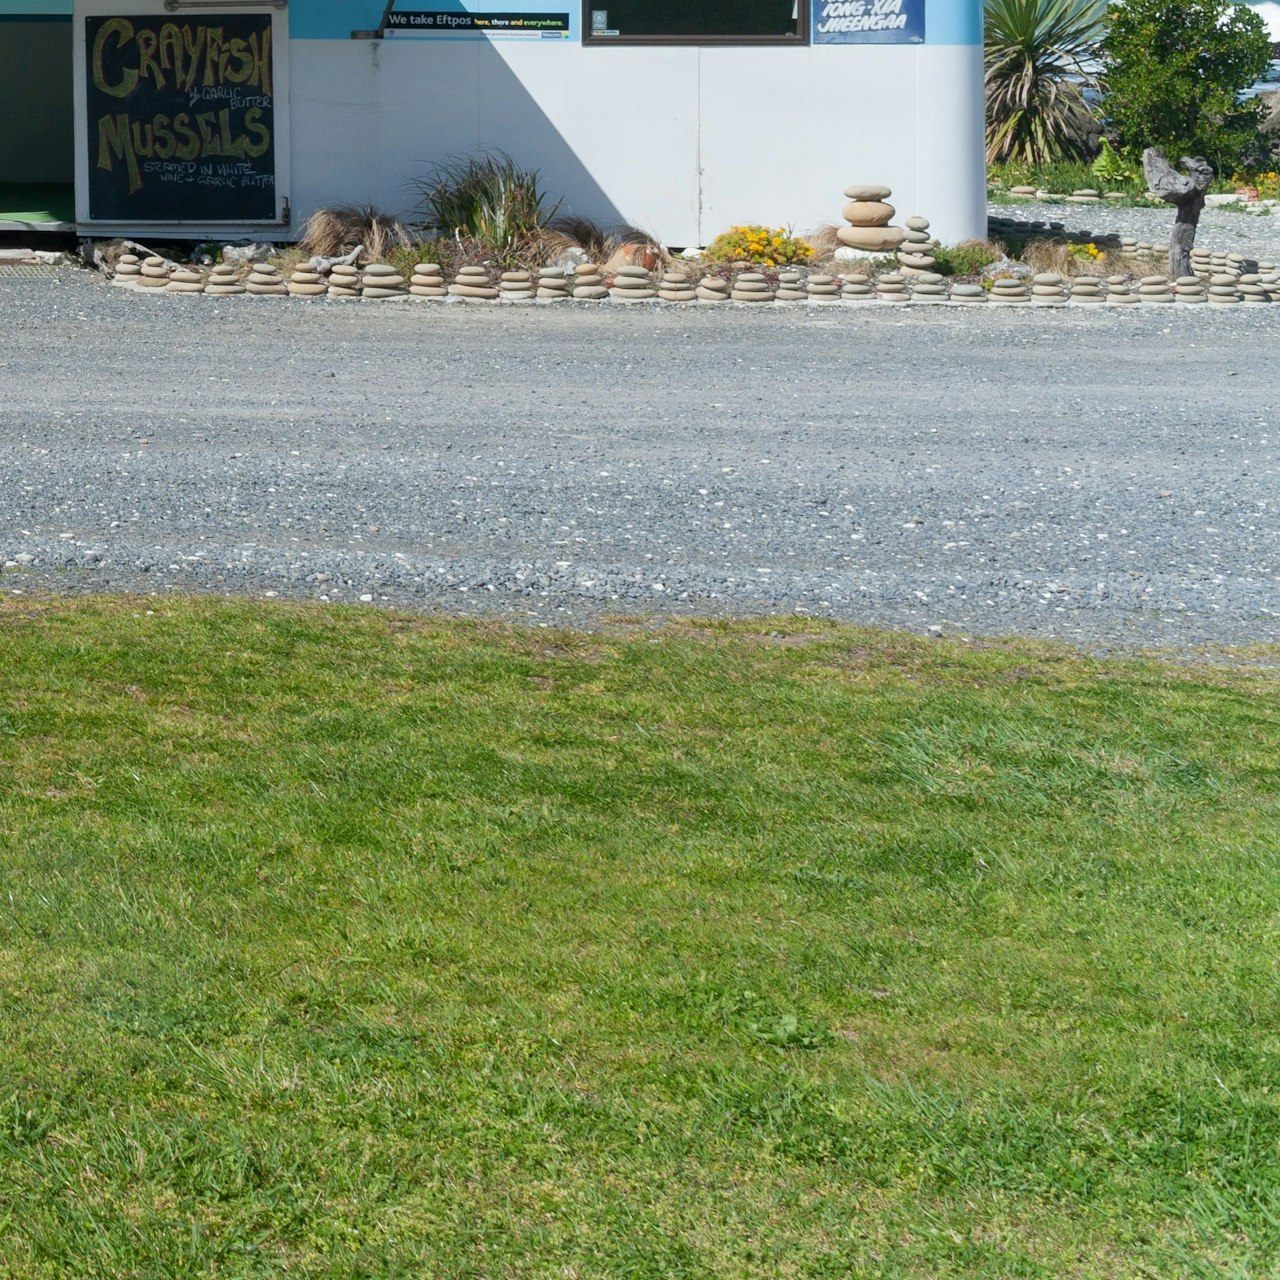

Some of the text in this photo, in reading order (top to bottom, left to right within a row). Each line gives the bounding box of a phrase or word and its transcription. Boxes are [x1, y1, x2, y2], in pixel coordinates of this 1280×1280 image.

[389, 14, 408, 25] We
[409, 14, 434, 25] take
[436, 14, 472, 27] Eftpos
[491, 18, 509, 26] there
[510, 18, 523, 26] and
[817, 14, 908, 33] JHEENGAA
[202, 86, 241, 100] GARLIC
[230, 95, 272, 110] BUTTER
[143, 161, 257, 176] STEAMED IN WHITE
[196, 175, 237, 188] GARLIC
